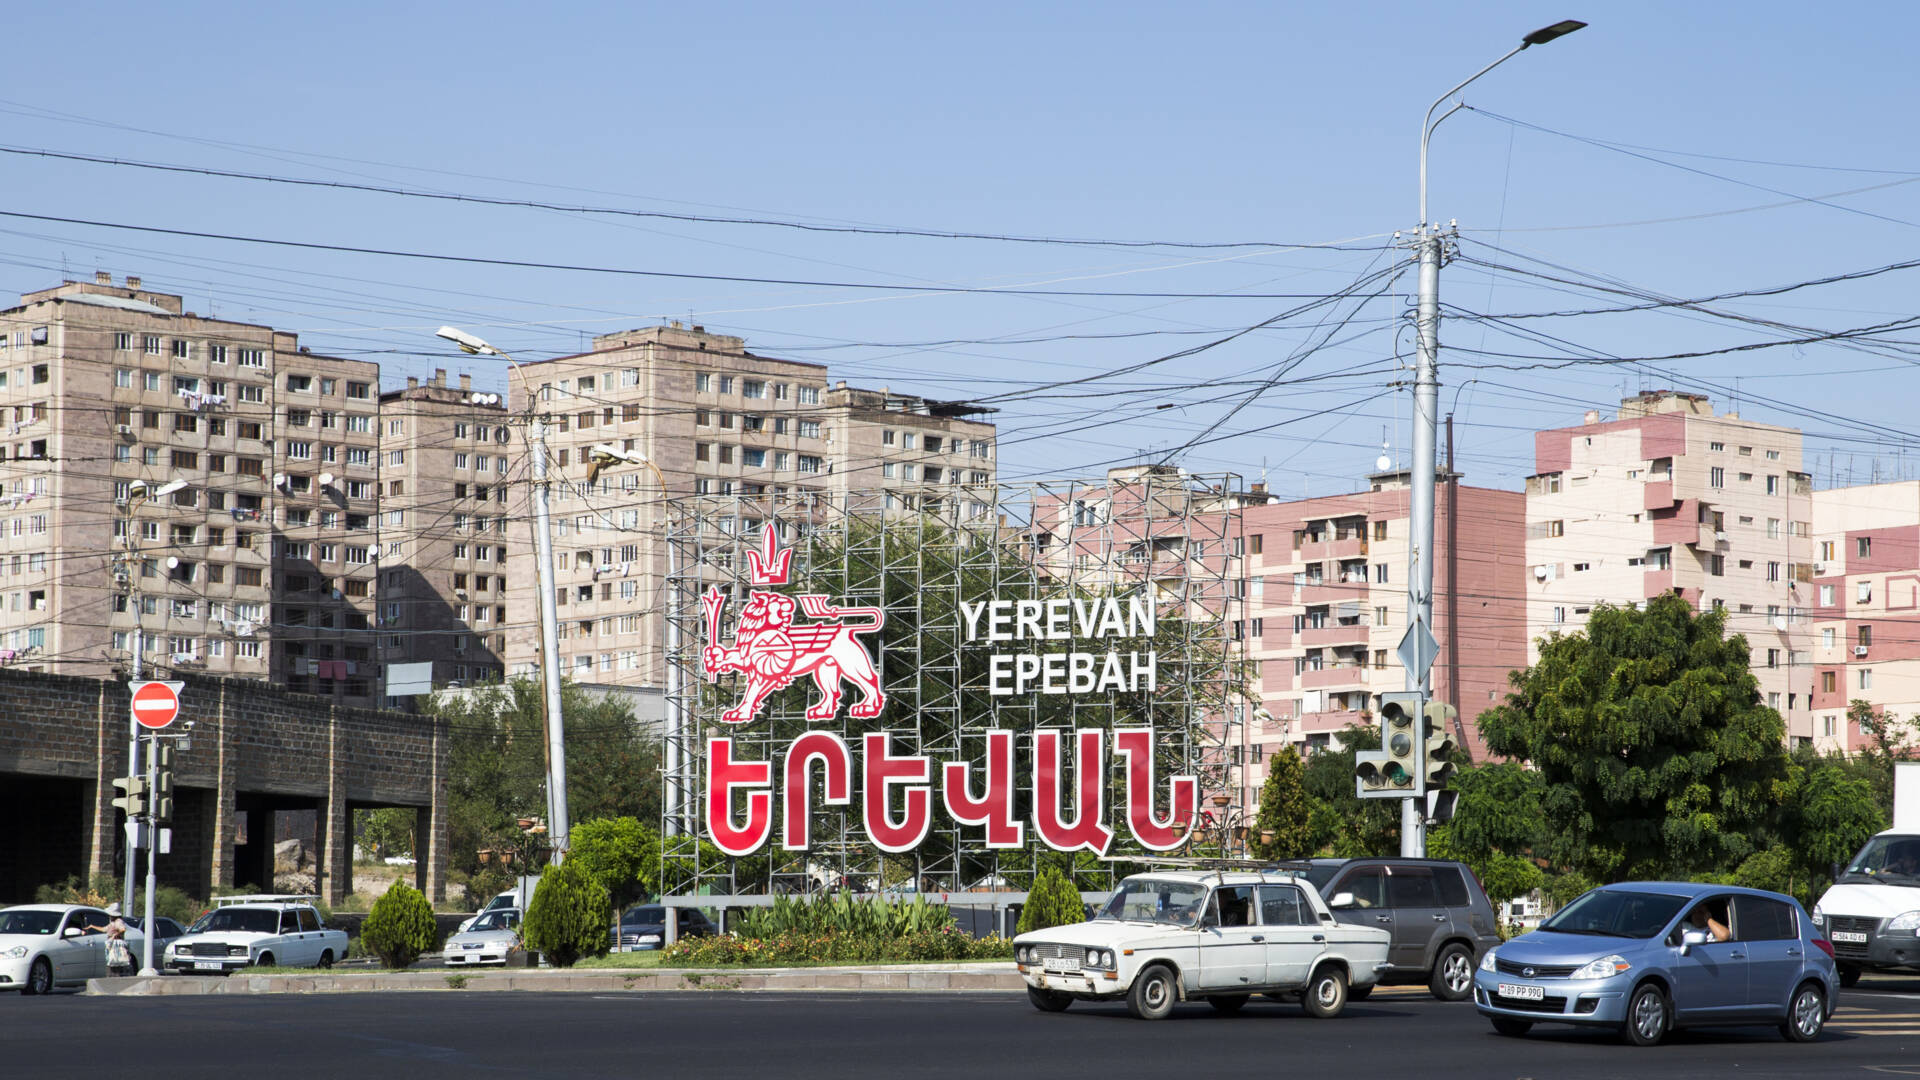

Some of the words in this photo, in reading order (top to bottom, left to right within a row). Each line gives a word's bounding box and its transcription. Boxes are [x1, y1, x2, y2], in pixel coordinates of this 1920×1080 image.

[961, 597, 1156, 641] YEREVAN
[990, 651, 1157, 695] ЕРЕВАН
[707, 728, 1198, 857] ԵՐԵՎԱՆ
[1516, 986, 1527, 996] PP
[1528, 987, 1542, 998] 990
